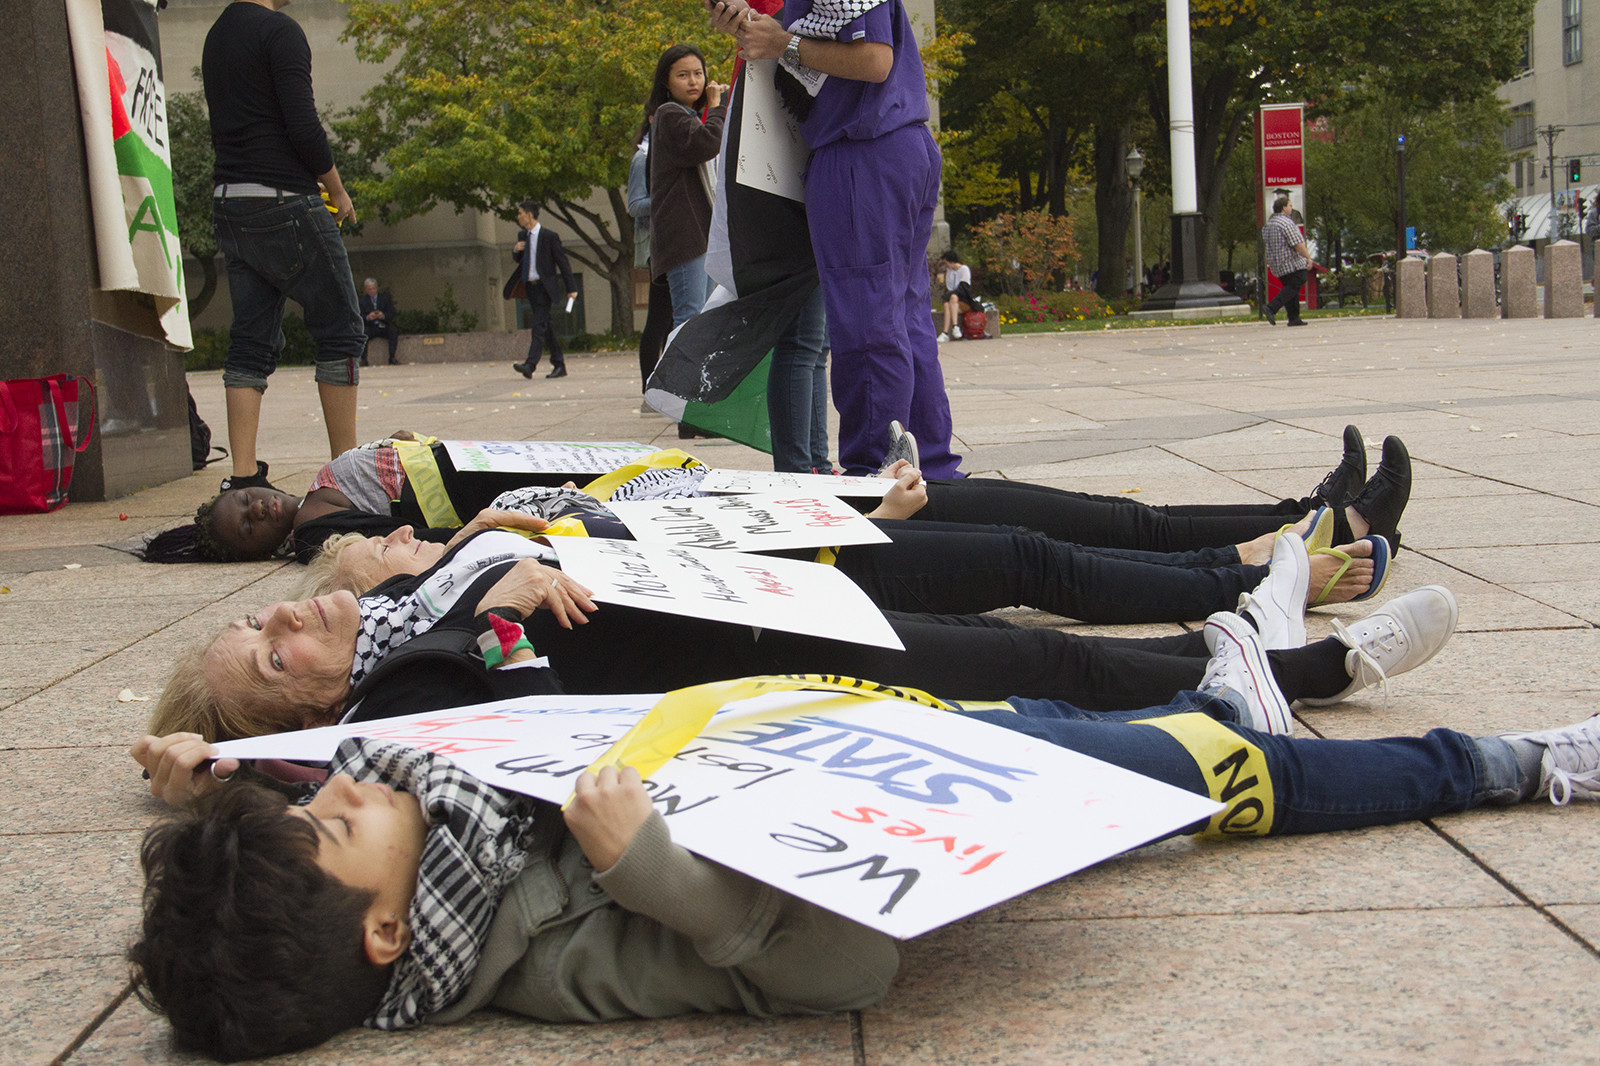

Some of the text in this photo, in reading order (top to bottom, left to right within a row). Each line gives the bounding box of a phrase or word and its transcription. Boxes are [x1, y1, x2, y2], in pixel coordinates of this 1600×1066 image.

[131, 67, 165, 149] FREE
[1266, 131, 1300, 140] BOSTON
[1266, 138, 1300, 146] UNIVERSITY
[1277, 176, 1297, 184] Legacy
[697, 721, 1014, 806] STATE
[769, 822, 921, 916] We
[831, 806, 1007, 876] lives
